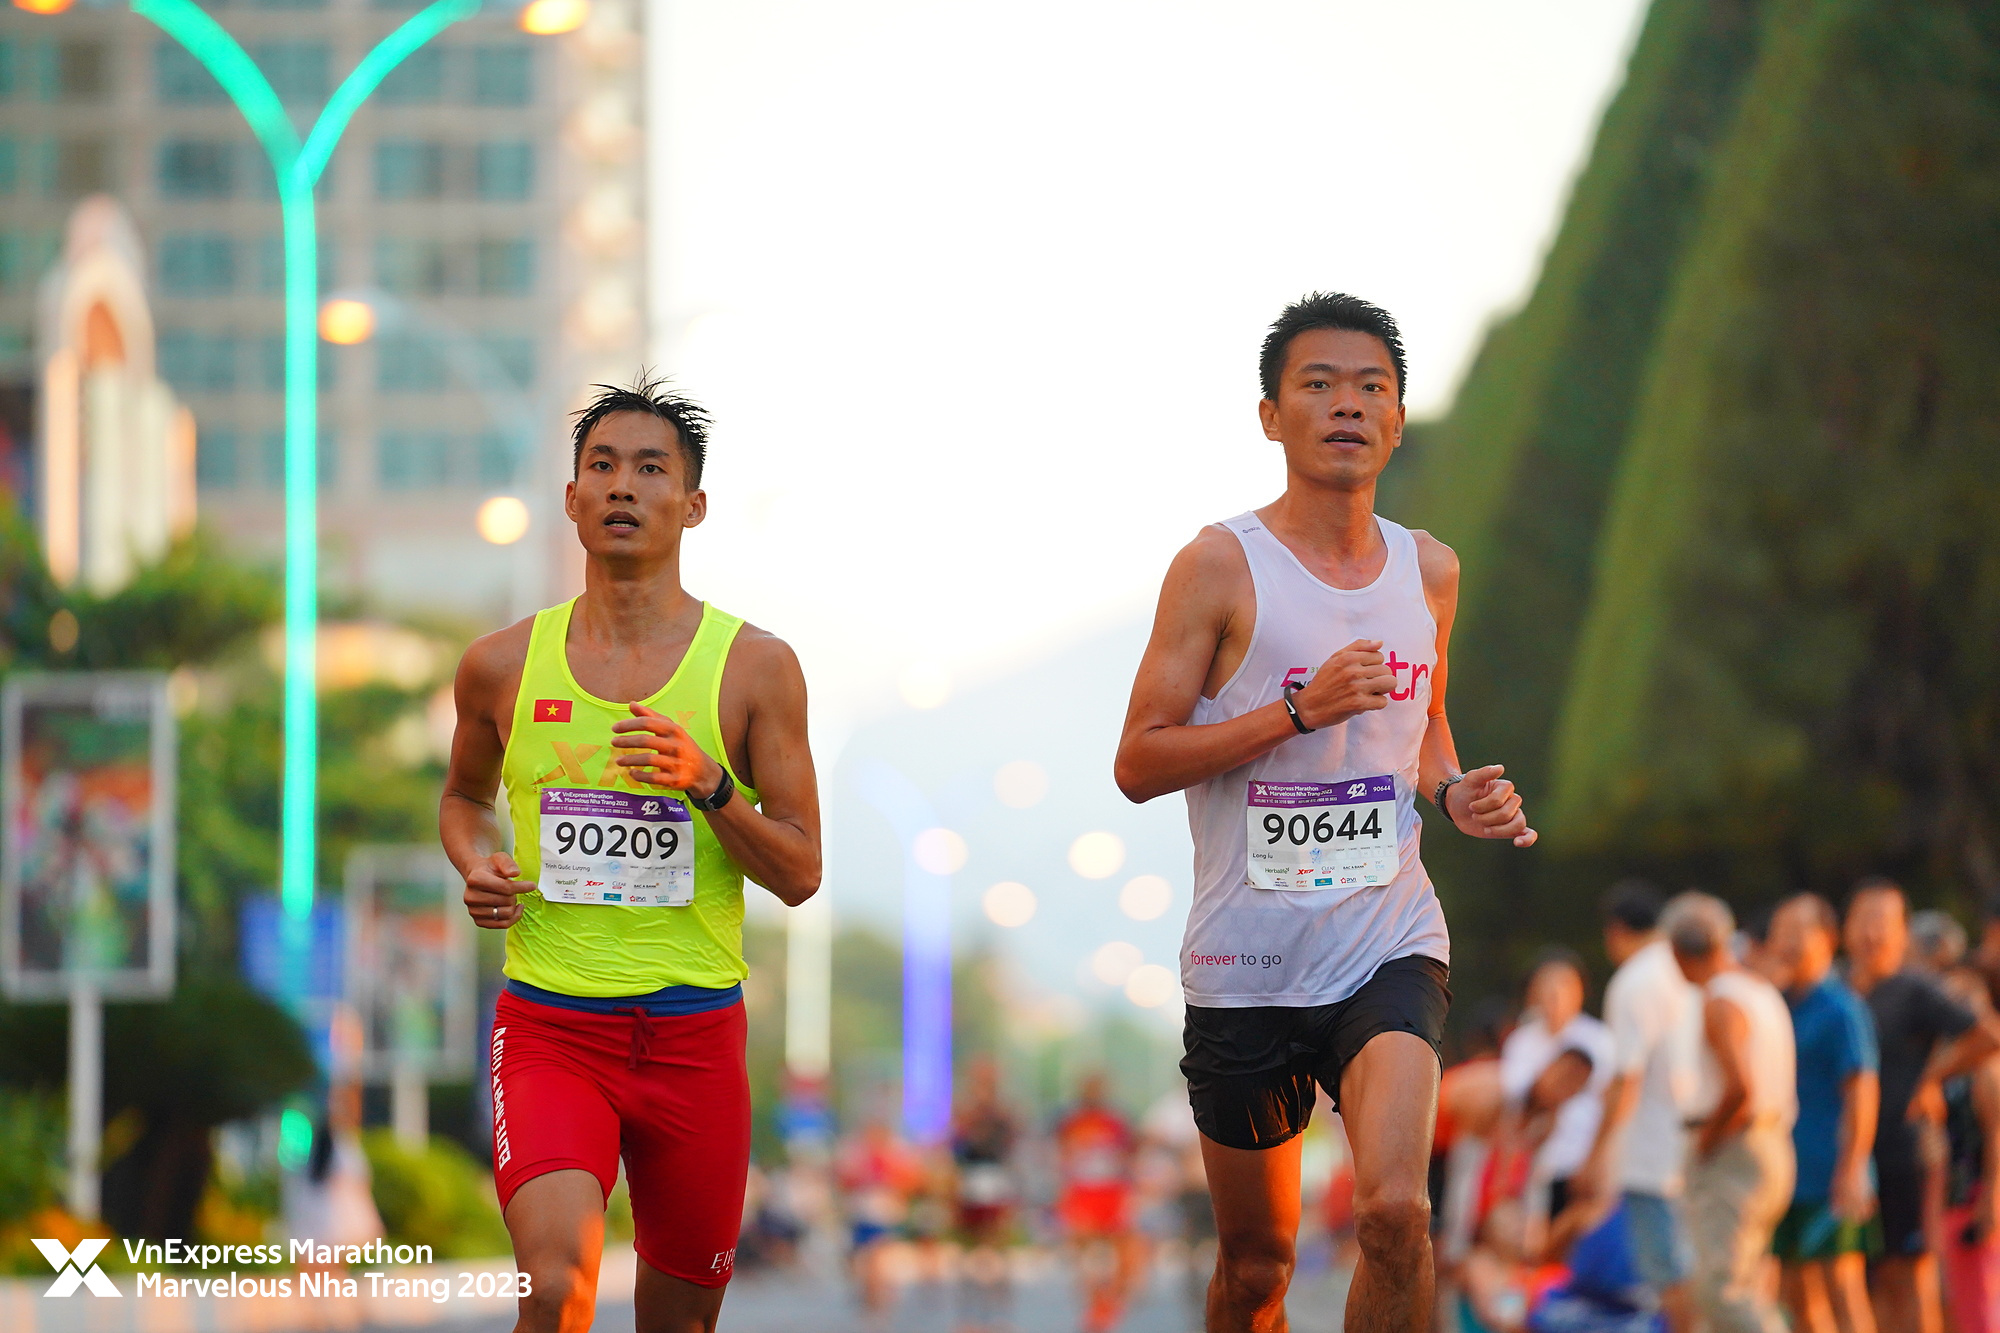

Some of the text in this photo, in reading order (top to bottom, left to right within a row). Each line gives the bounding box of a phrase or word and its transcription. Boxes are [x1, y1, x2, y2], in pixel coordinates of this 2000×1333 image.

[588, 792, 614, 800] Marathon
[1346, 782, 1366, 800] 42
[641, 800, 660, 816] 42
[1262, 808, 1382, 846] 90644
[556, 822, 678, 860] 90209
[1191, 951, 1282, 969] forever to go
[496, 1118, 512, 1171] ELITE
